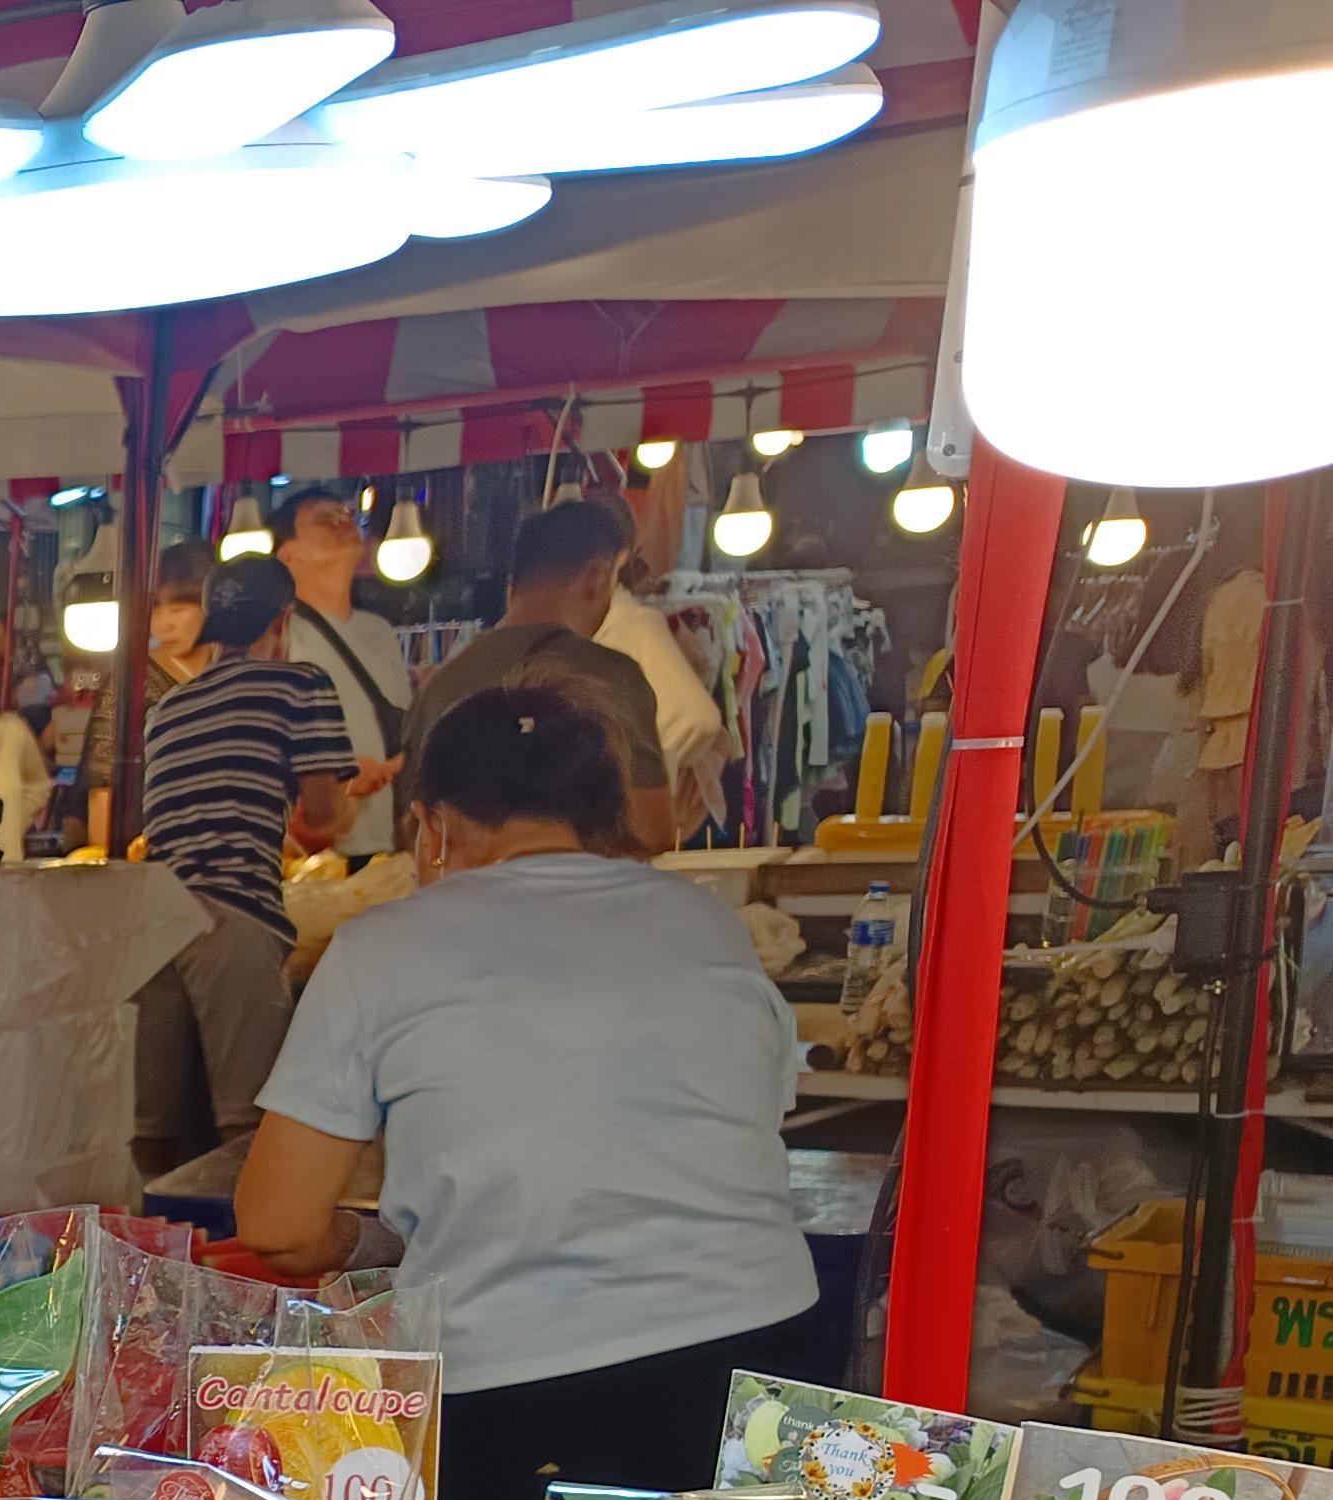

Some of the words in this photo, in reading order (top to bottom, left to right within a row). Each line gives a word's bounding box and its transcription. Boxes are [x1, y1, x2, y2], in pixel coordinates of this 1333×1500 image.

[198, 1377, 427, 1423] Cantaloupe
[821, 1443, 870, 1467] Thank
[828, 1463, 855, 1478] you
